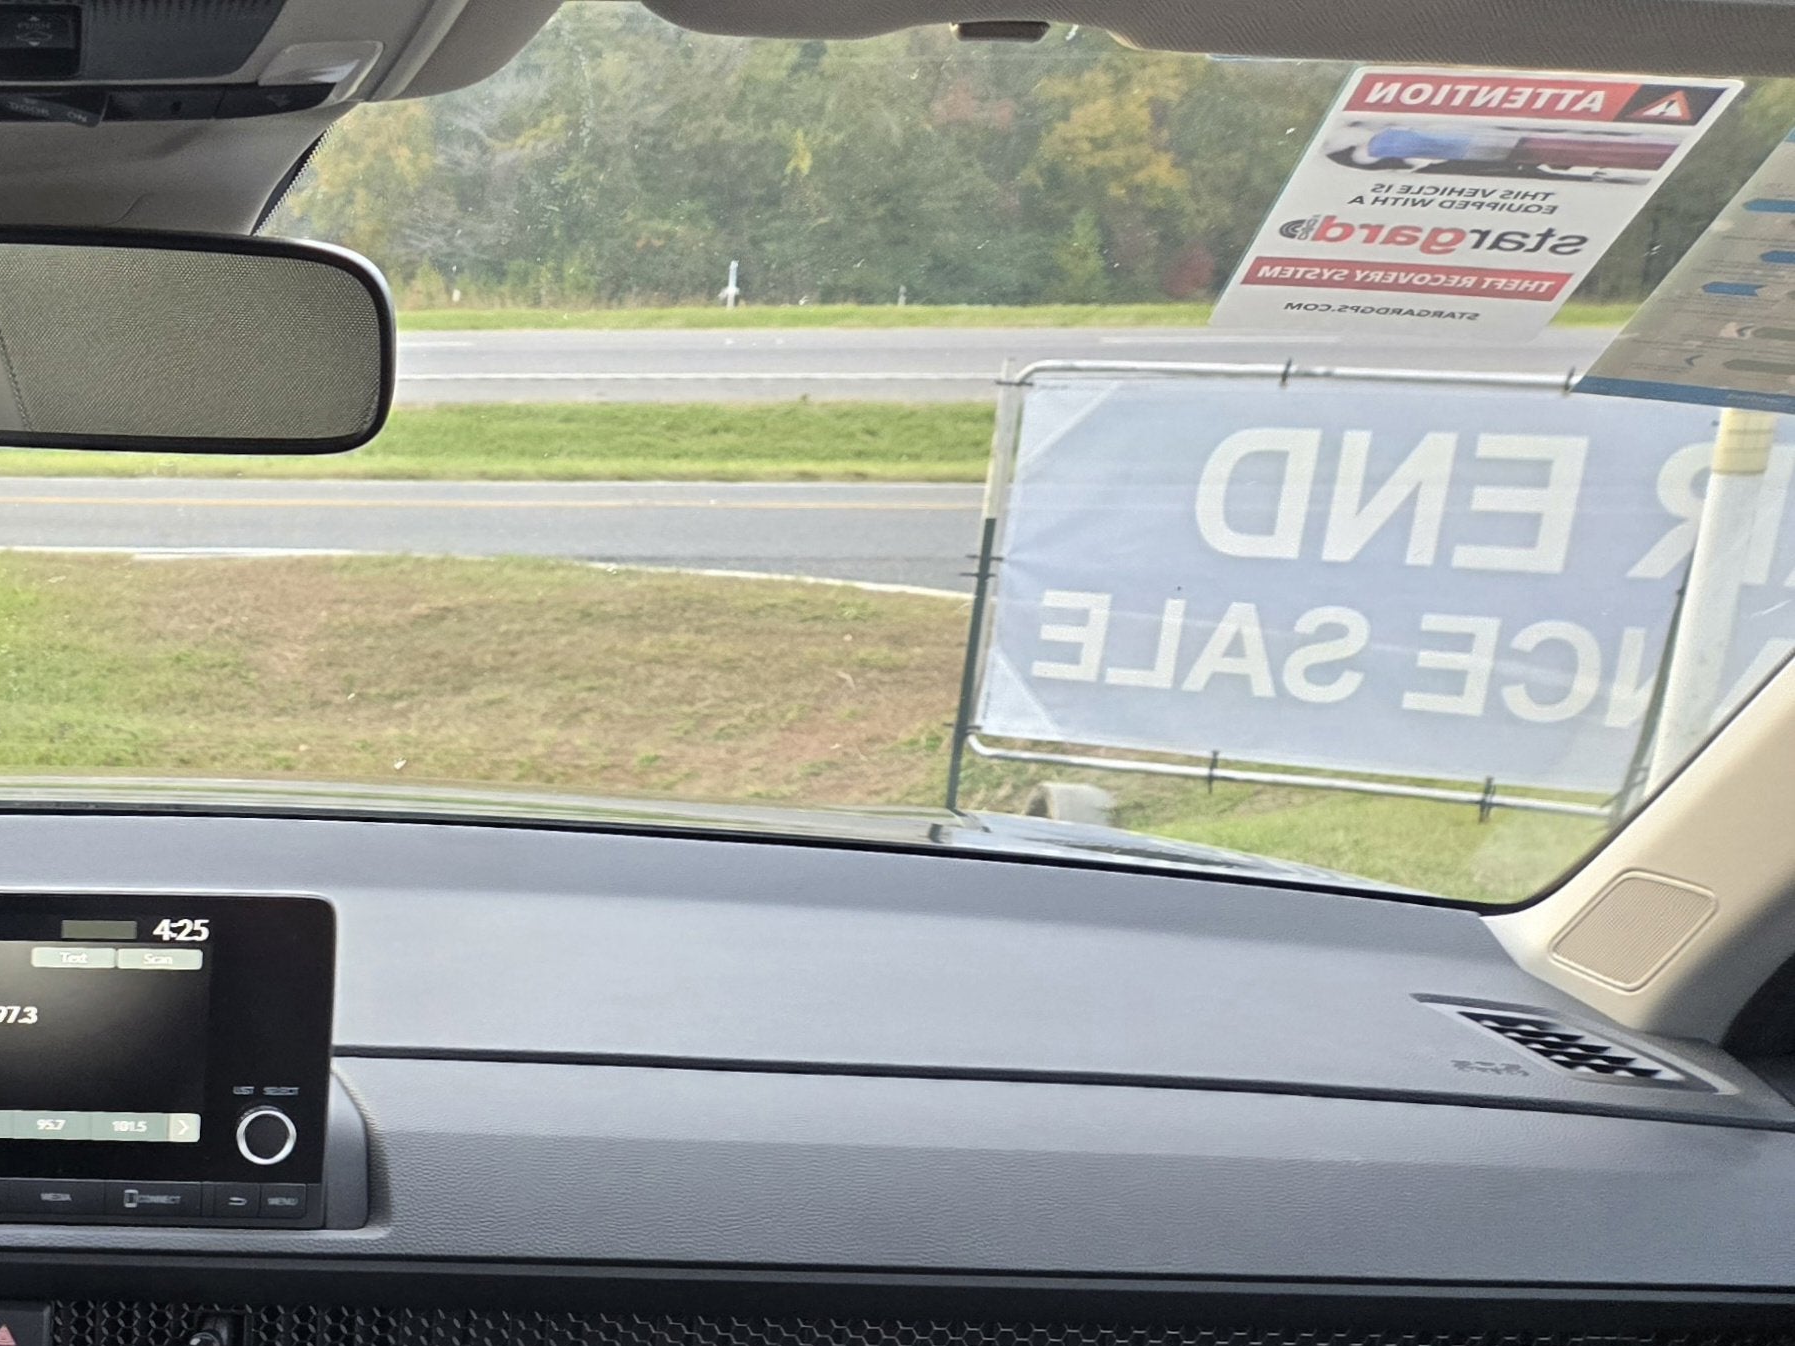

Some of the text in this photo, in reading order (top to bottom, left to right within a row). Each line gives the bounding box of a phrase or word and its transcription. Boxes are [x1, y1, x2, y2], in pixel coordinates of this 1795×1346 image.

[152, 918, 211, 942] 4:25
[59, 951, 88, 964] Text
[143, 953, 173, 965] Scan
[36, 1118, 66, 1131] 95.7
